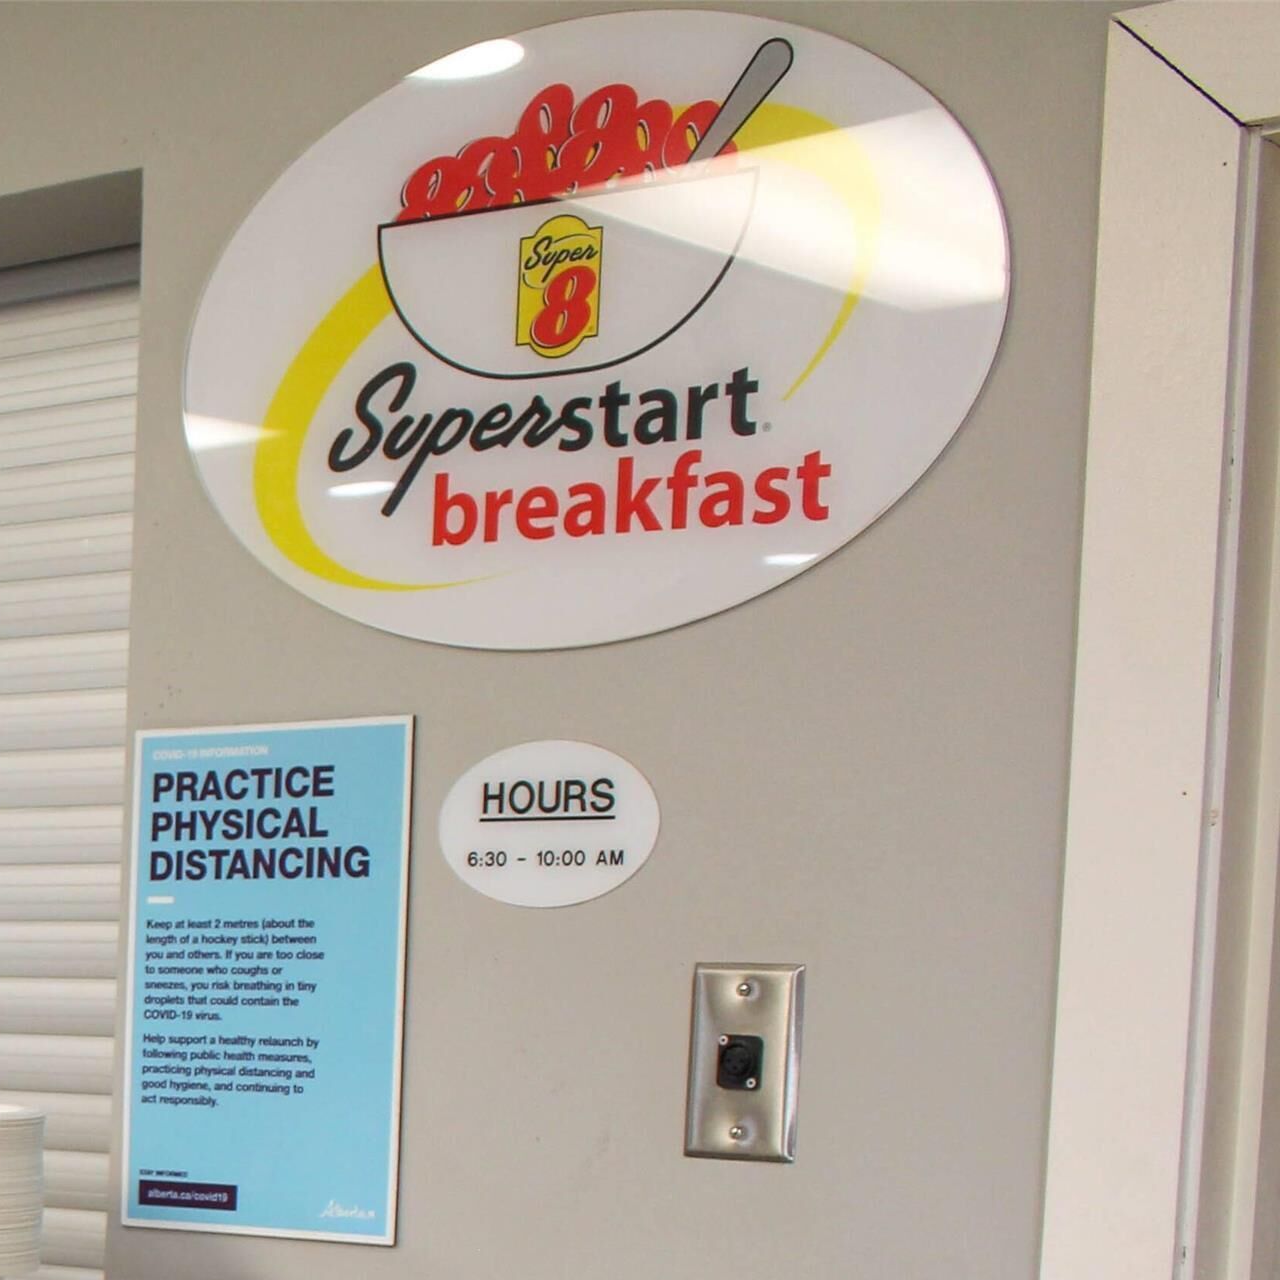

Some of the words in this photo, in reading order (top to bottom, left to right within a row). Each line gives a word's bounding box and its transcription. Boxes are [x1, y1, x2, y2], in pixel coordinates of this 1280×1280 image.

[524, 236, 598, 283] Super
[530, 265, 596, 348] 8
[328, 361, 760, 517] Superstart
[431, 449, 832, 547] breakfast
[153, 765, 335, 803] PRACTICE
[482, 778, 616, 814] HOURS
[151, 806, 329, 842] PHYSICAL
[149, 845, 370, 881] DISTANCING
[467, 851, 507, 867] 6:30
[537, 850, 586, 866] 10:00
[595, 850, 624, 865] AM
[146, 919, 172, 931] Keep
[175, 920, 184, 929] at
[187, 919, 211, 929] least
[214, 919, 221, 929] 2
[223, 920, 259, 929] metres
[262, 919, 295, 931] (about
[298, 919, 315, 929] the
[146, 934, 177, 946] length
[180, 935, 189, 944] of
[202, 935, 237, 946] hockey
[241, 934, 269, 945] stick)
[271, 935, 316, 944] between
[145, 952, 163, 961] you
[166, 950, 184, 959] and
[187, 950, 221, 959] others.
[235, 952, 253, 961] you
[276, 951, 293, 959] too
[296, 950, 324, 960] close
[145, 965, 155, 974] to
[206, 965, 228, 974] who
[231, 965, 268, 977] coughs
[144, 981, 188, 991] sneezes,
[191, 982, 209, 992] you
[212, 980, 229, 990] risk
[233, 981, 282, 992] breathing
[285, 981, 294, 990] in
[297, 981, 317, 992] tiny
[144, 995, 184, 1006] droplets
[187, 995, 207, 1005] that
[210, 996, 238, 1005] could
[241, 996, 280, 1006] contain
[283, 997, 299, 1006] the
[144, 1010, 192, 1020] COVID-19
[196, 1012, 222, 1020] virus.
[143, 1034, 165, 1045] Help
[169, 1035, 207, 1045] support
[218, 1035, 255, 1047] healthy
[259, 1036, 303, 1047] relaunch
[306, 1037, 319, 1049] by
[142, 1049, 187, 1061] following
[190, 1050, 221, 1061] public
[224, 1051, 255, 1061] health
[142, 1065, 191, 1076] practicing
[194, 1066, 235, 1077] physical
[239, 1067, 292, 1079] distancing
[295, 1069, 315, 1078] and
[142, 1080, 166, 1090] good
[214, 1082, 233, 1091] and
[236, 1083, 290, 1095] continuing
[293, 1084, 304, 1093] to
[141, 1095, 157, 1103] act
